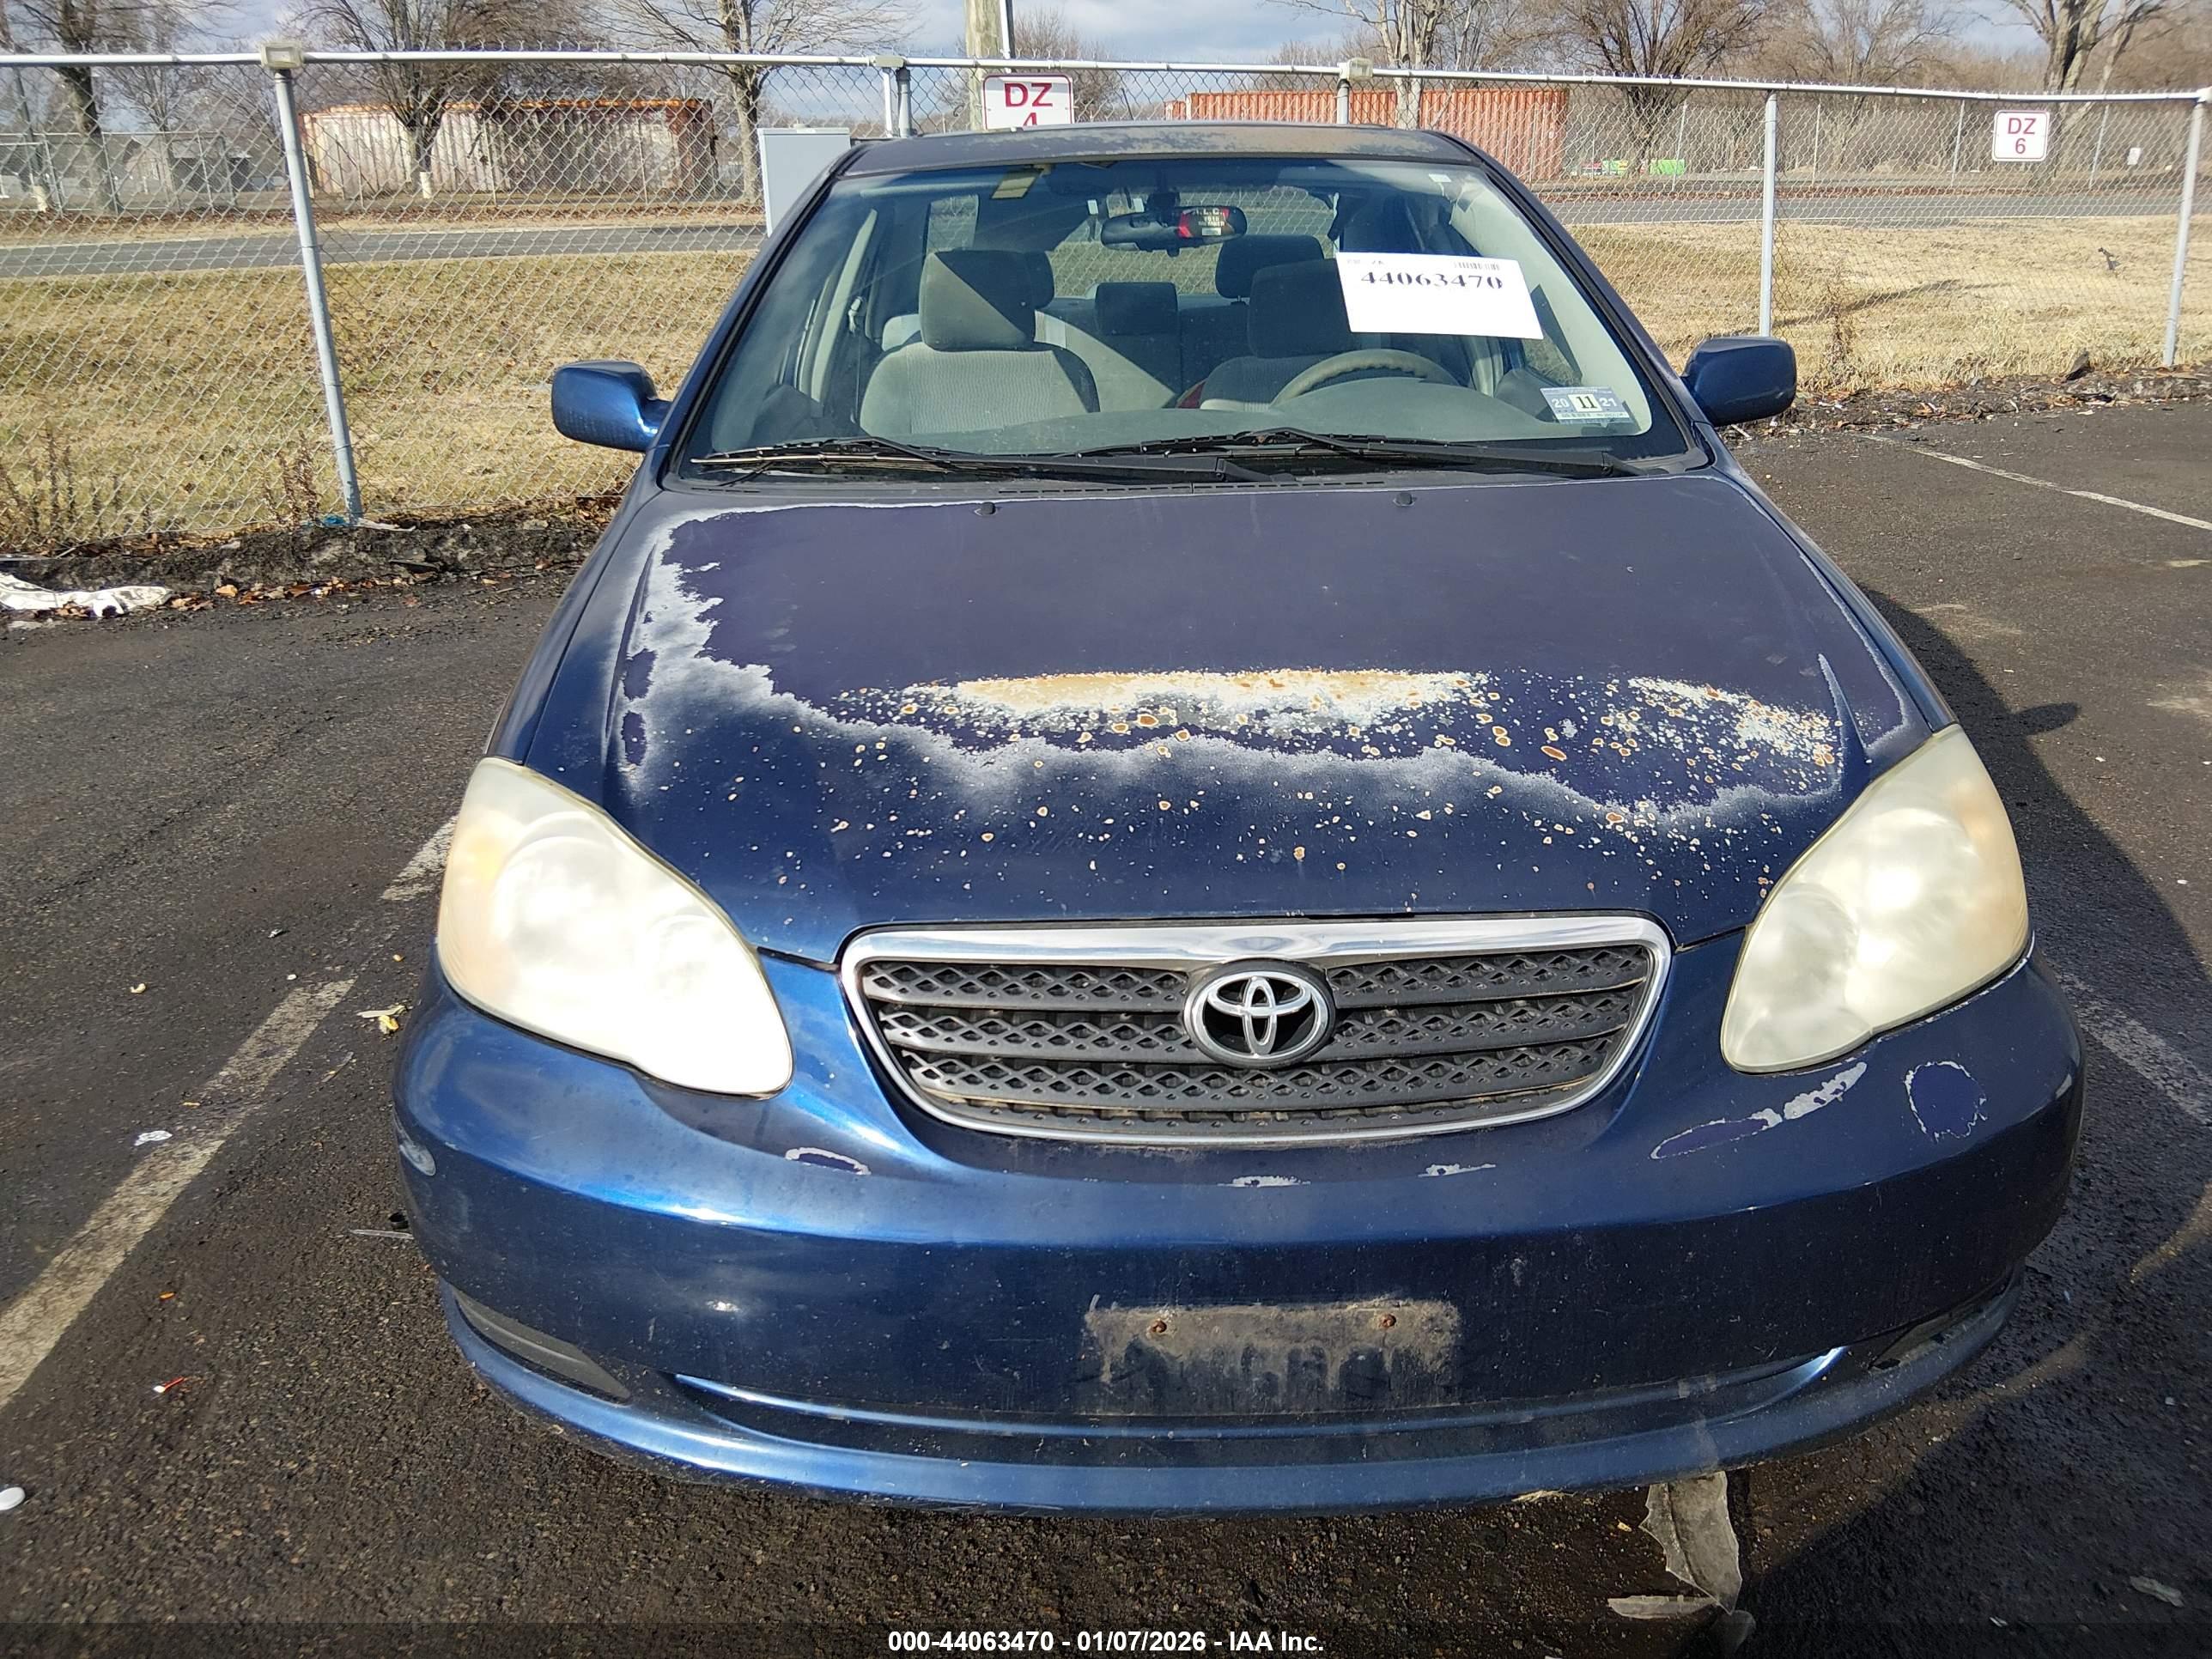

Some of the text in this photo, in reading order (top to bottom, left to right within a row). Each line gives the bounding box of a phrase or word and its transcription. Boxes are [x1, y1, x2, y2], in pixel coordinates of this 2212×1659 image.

[1004, 82, 1054, 107] DZ
[2007, 117, 2037, 135] DZ
[2014, 137, 2027, 155] 6
[1360, 271, 1503, 289] 44063470
[1551, 395, 1618, 409] 20 11 21
